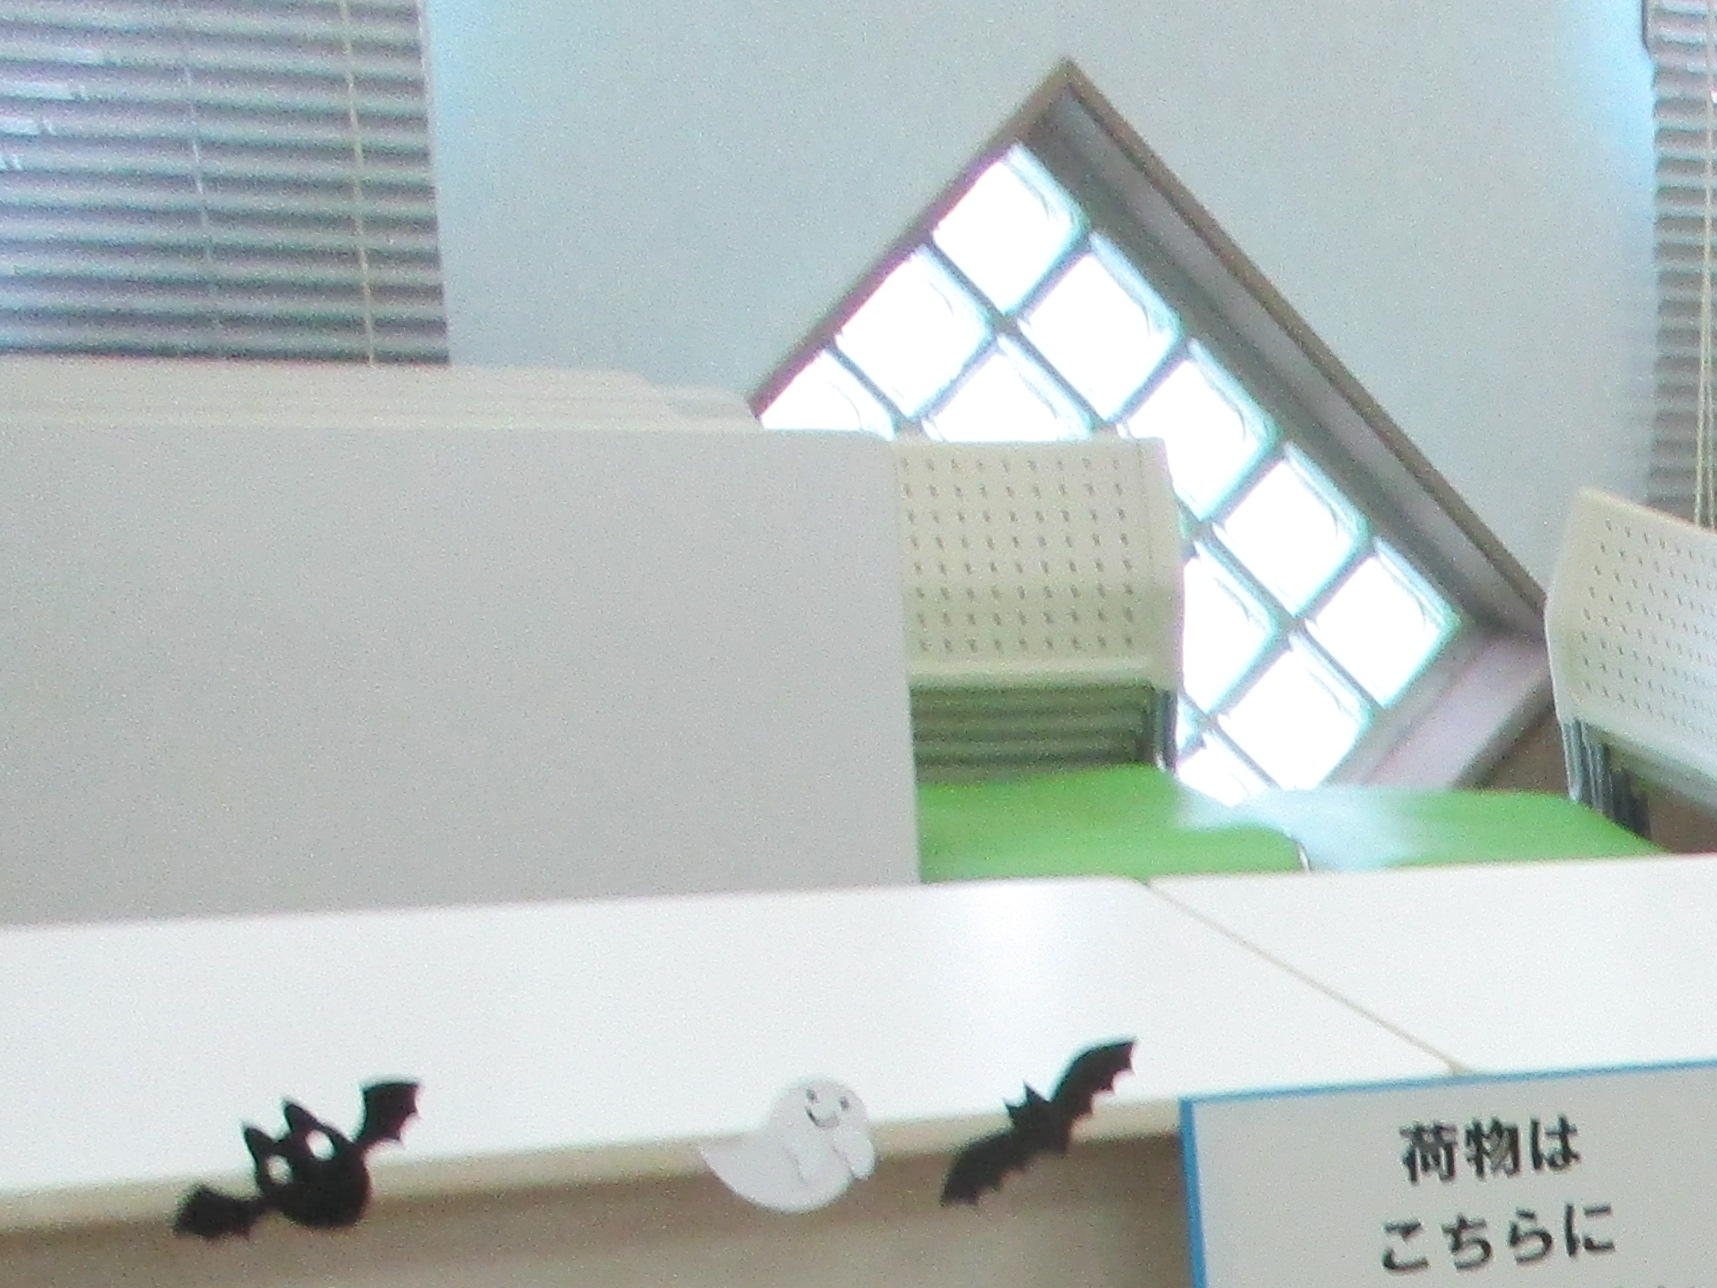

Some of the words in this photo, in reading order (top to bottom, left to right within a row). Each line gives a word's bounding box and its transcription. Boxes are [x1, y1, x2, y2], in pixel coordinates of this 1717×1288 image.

[1399, 1115, 1581, 1183] 荷物は
[1381, 1201, 1616, 1272] こちらに
